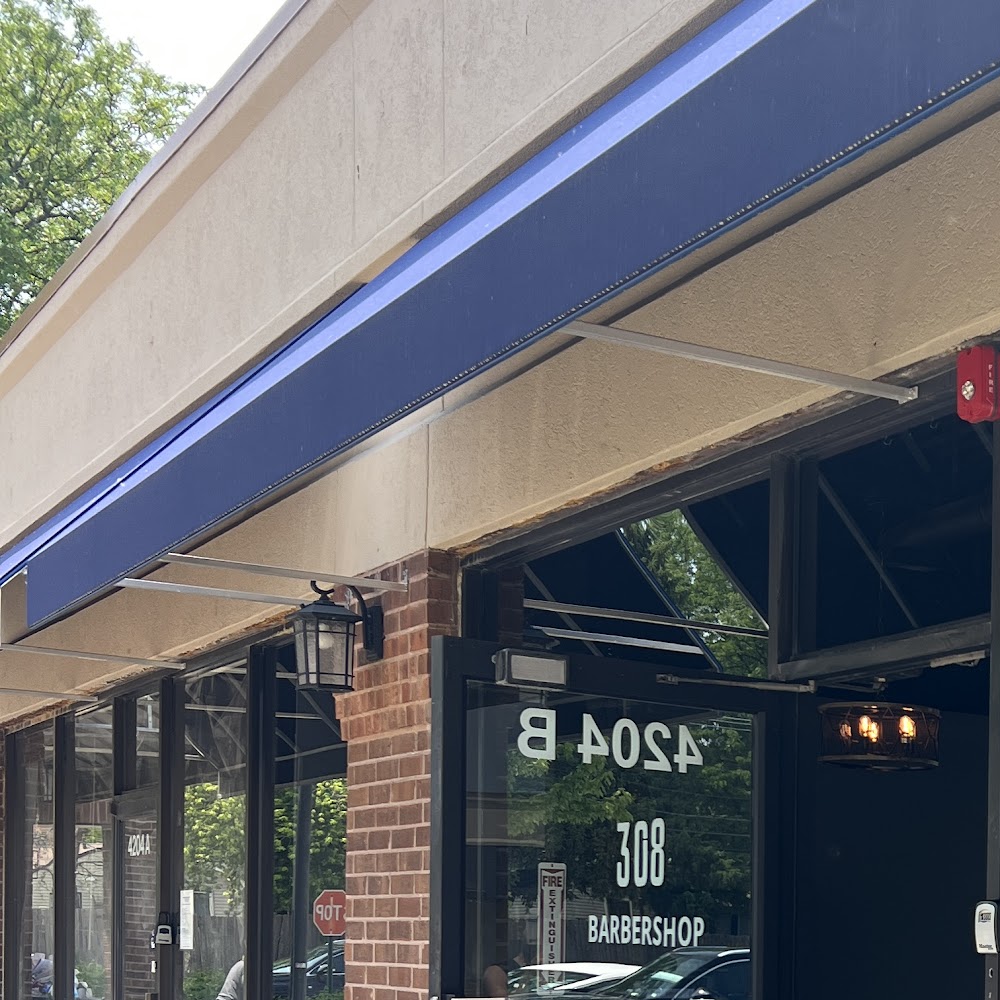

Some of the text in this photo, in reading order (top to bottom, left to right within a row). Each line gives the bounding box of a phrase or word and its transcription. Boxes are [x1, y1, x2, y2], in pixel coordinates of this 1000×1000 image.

[616, 817, 667, 887] 308
[542, 875, 563, 888] FIRE
[588, 914, 706, 947] BARBERSHOP
